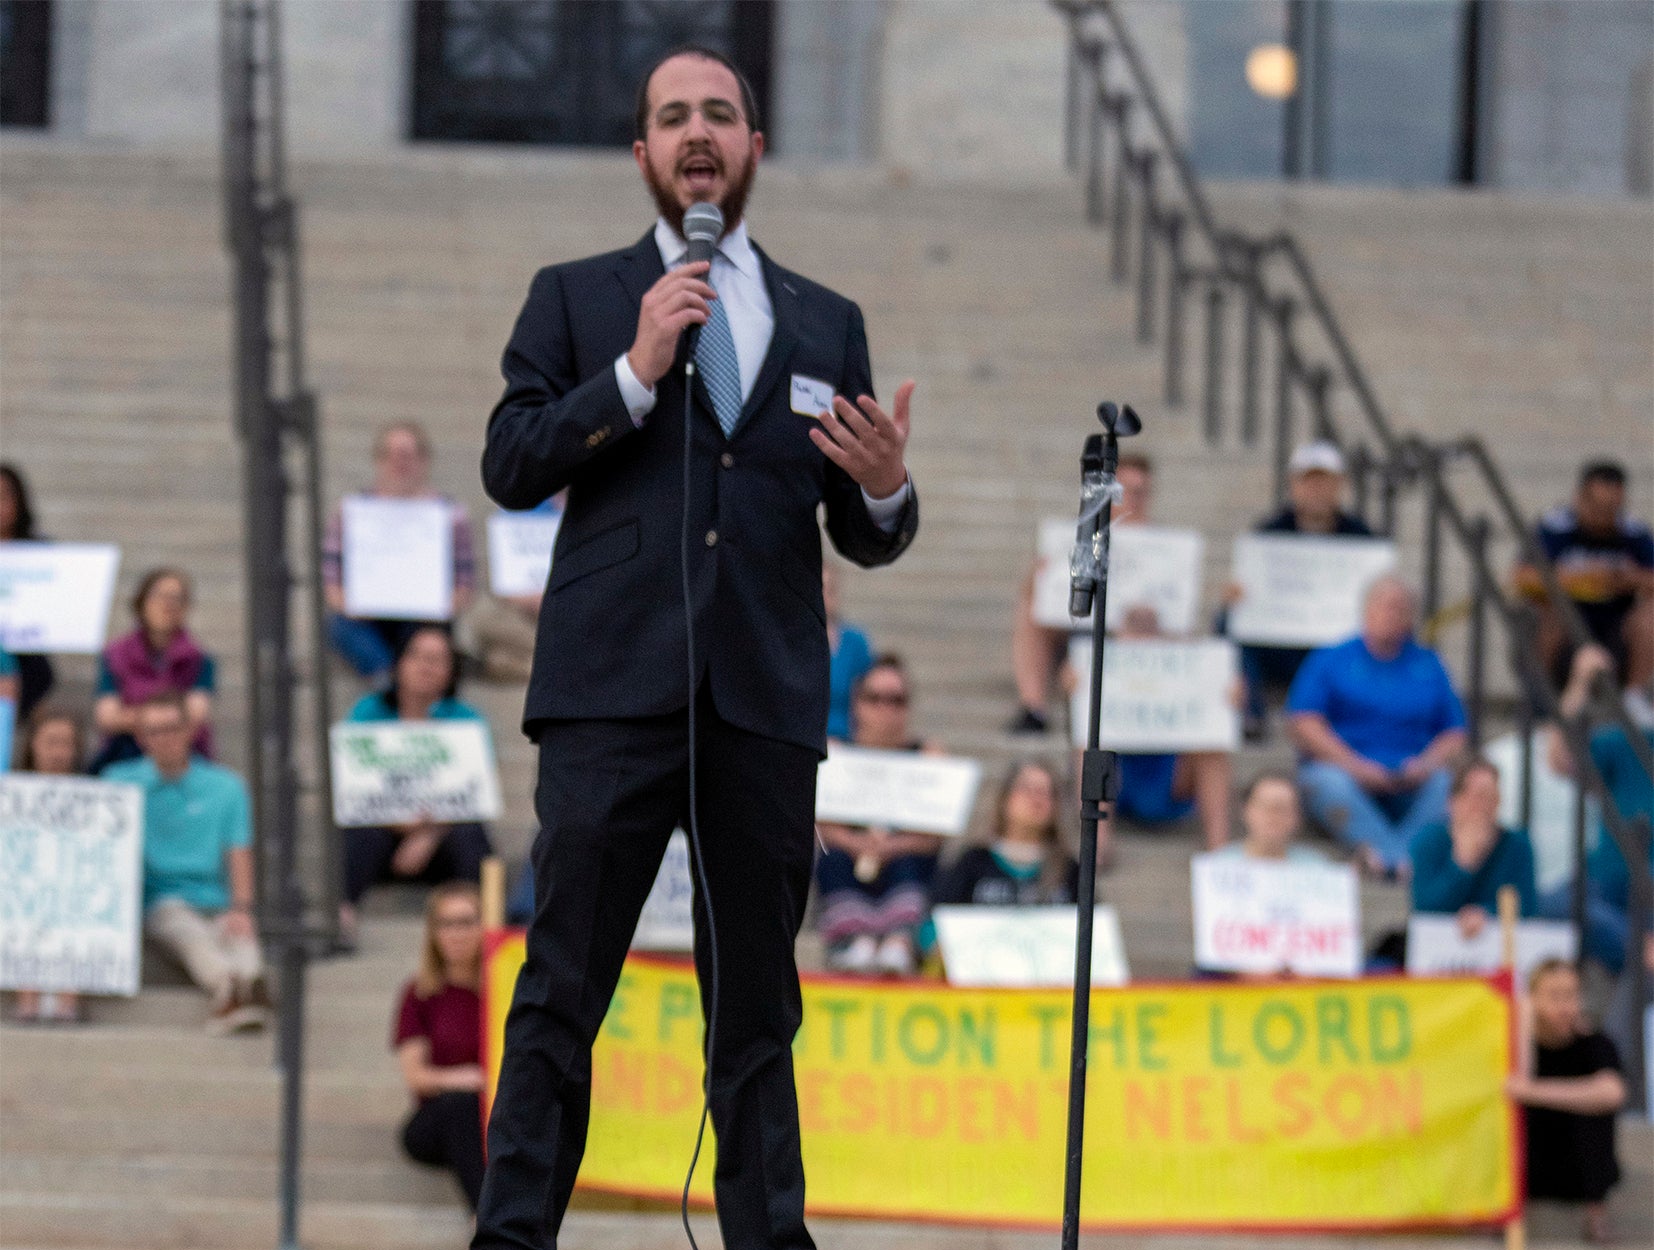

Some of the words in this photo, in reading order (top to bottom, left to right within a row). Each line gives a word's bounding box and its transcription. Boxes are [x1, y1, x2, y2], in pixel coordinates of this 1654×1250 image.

[656, 980, 998, 1069] PTION
[1026, 1003, 1170, 1071] THE
[1208, 993, 1412, 1069] LORD
[591, 1049, 698, 1117] ND
[800, 1069, 1090, 1143] ESIDEN
[1123, 1067, 1423, 1143] NELSON
